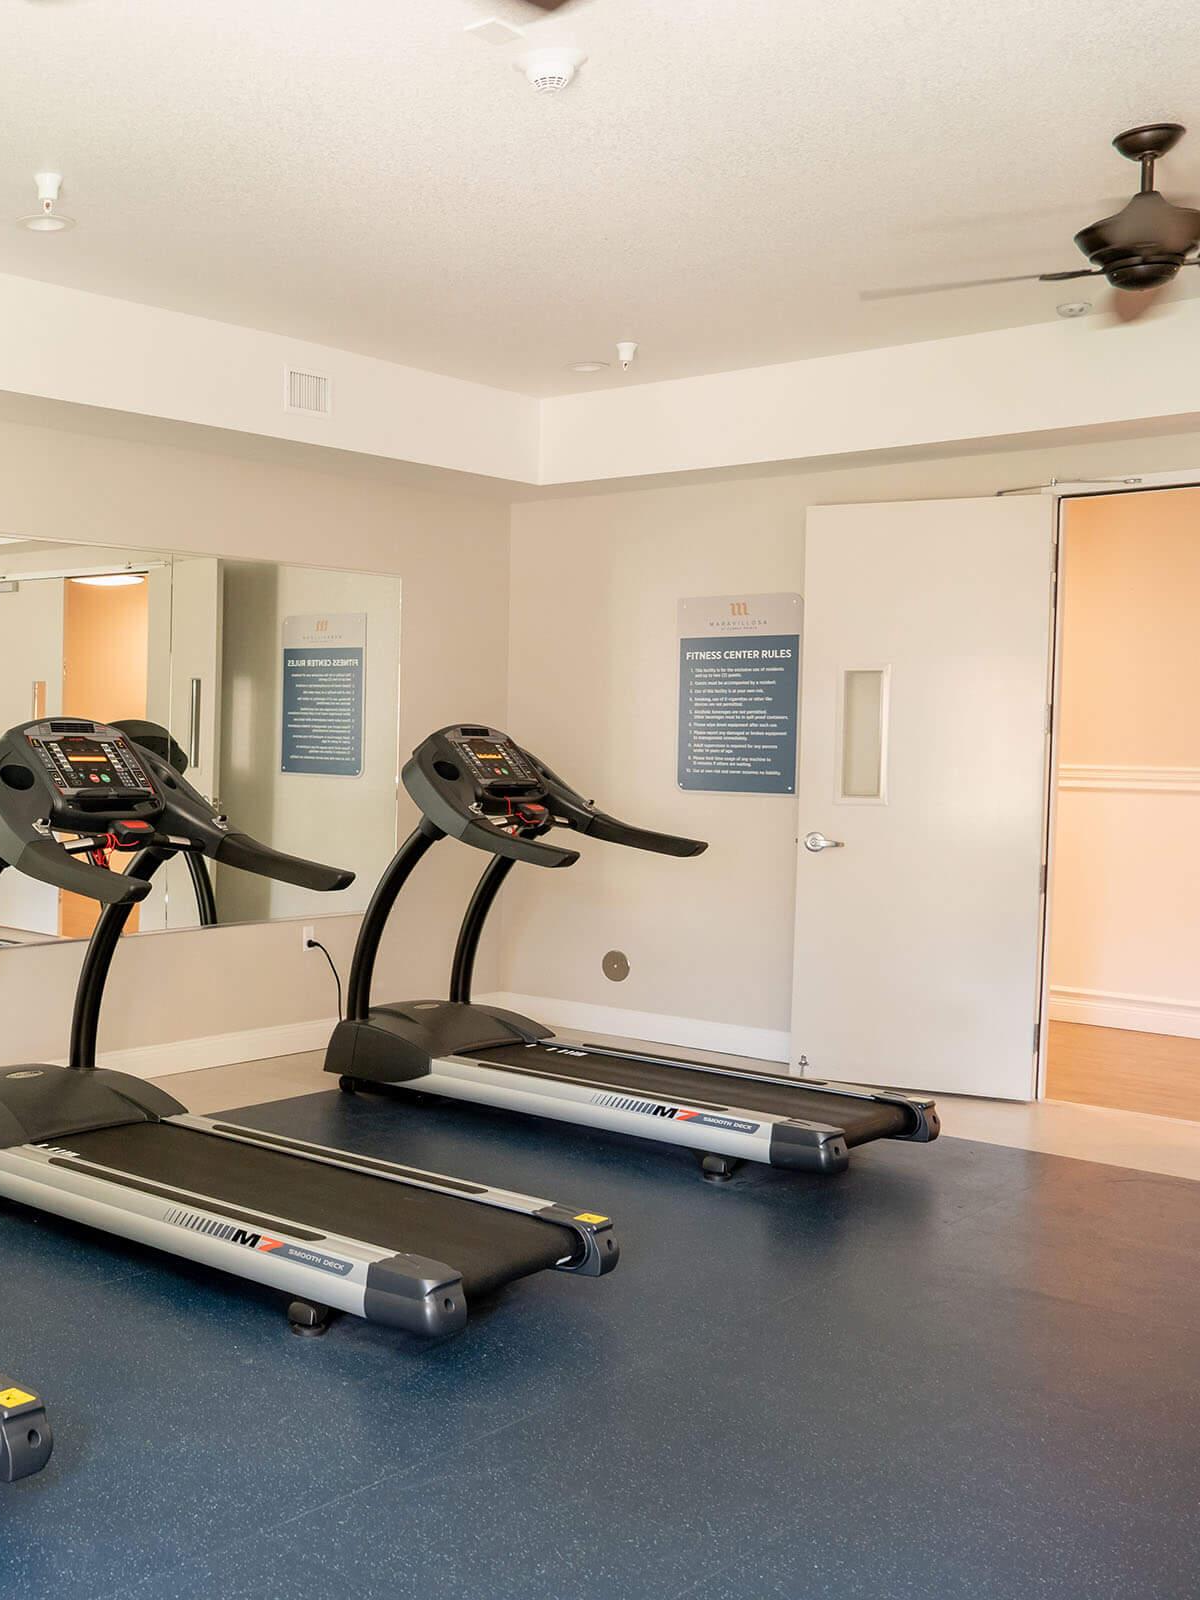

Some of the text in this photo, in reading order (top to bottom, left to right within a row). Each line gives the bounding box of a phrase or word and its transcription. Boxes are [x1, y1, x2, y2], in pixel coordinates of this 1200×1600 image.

[686, 649, 792, 660] FITNESS CENTER RULES
[652, 1105, 753, 1130] M7 SMOOTH DECK
[231, 1228, 345, 1271] M7 SMOOTH DECK
